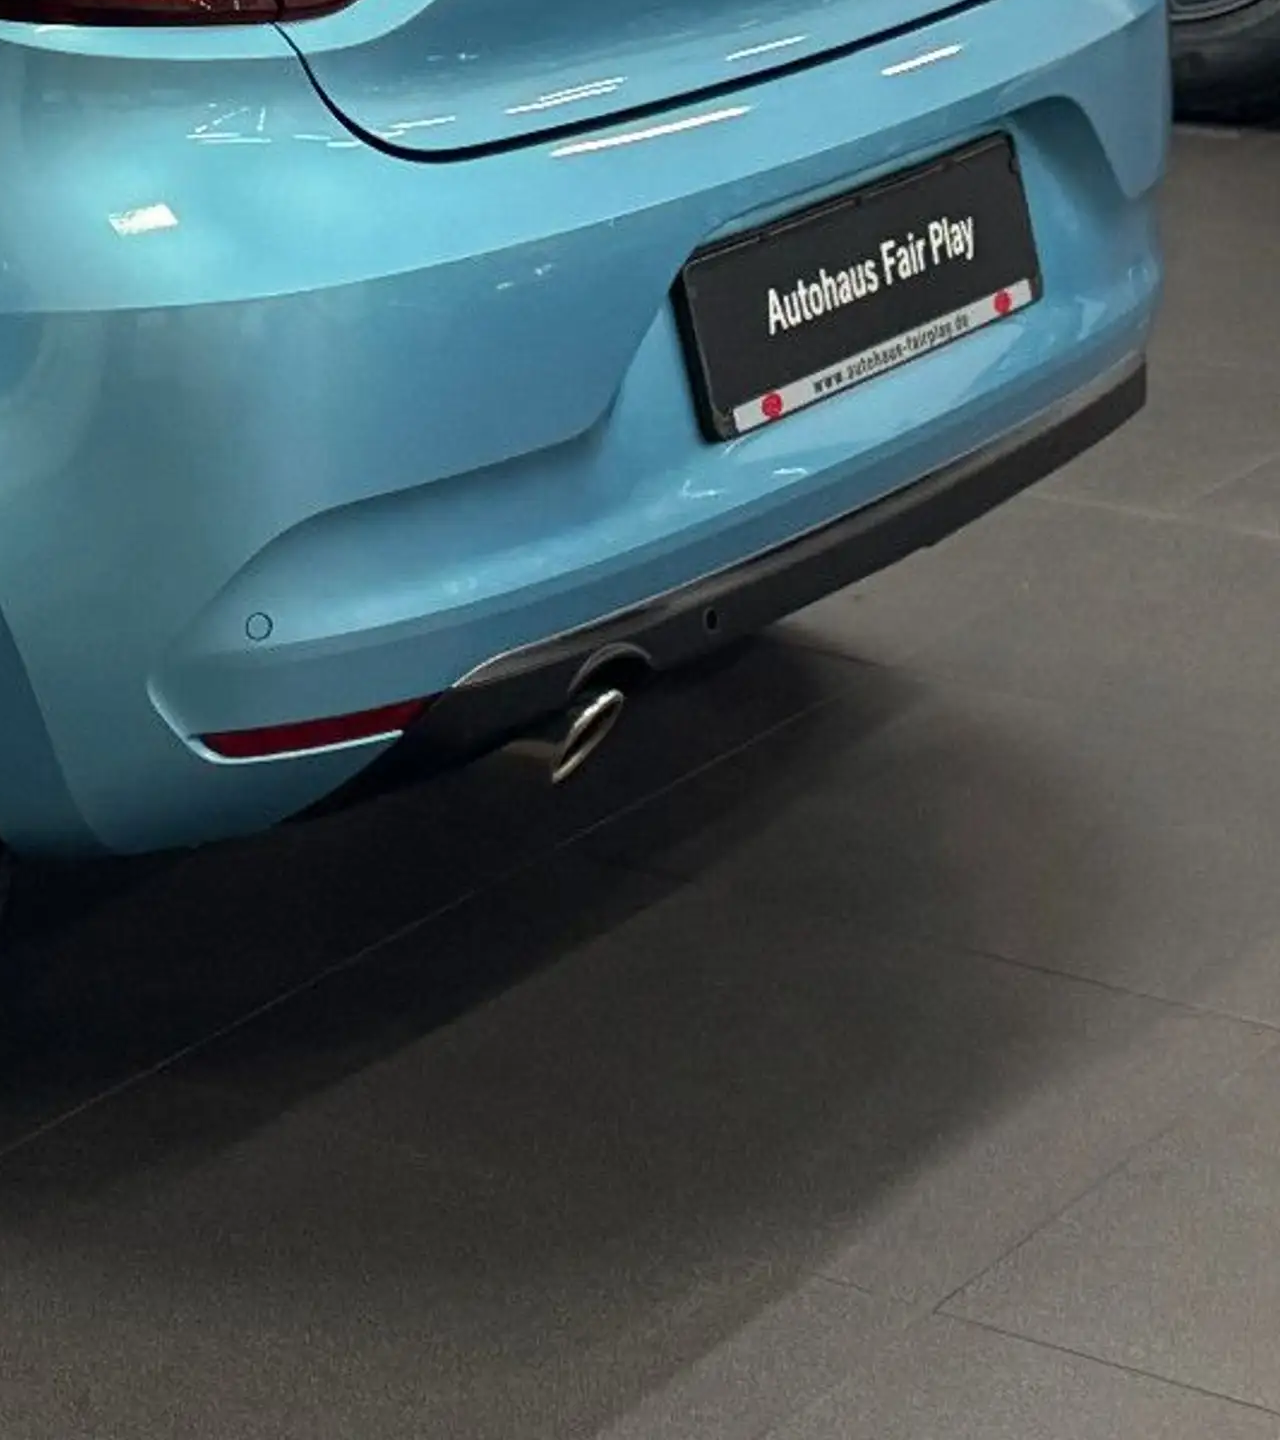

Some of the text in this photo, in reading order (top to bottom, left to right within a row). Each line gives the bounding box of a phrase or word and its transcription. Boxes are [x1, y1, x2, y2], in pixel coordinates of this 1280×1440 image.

[766, 215, 976, 336] Autohaus Fair Play
